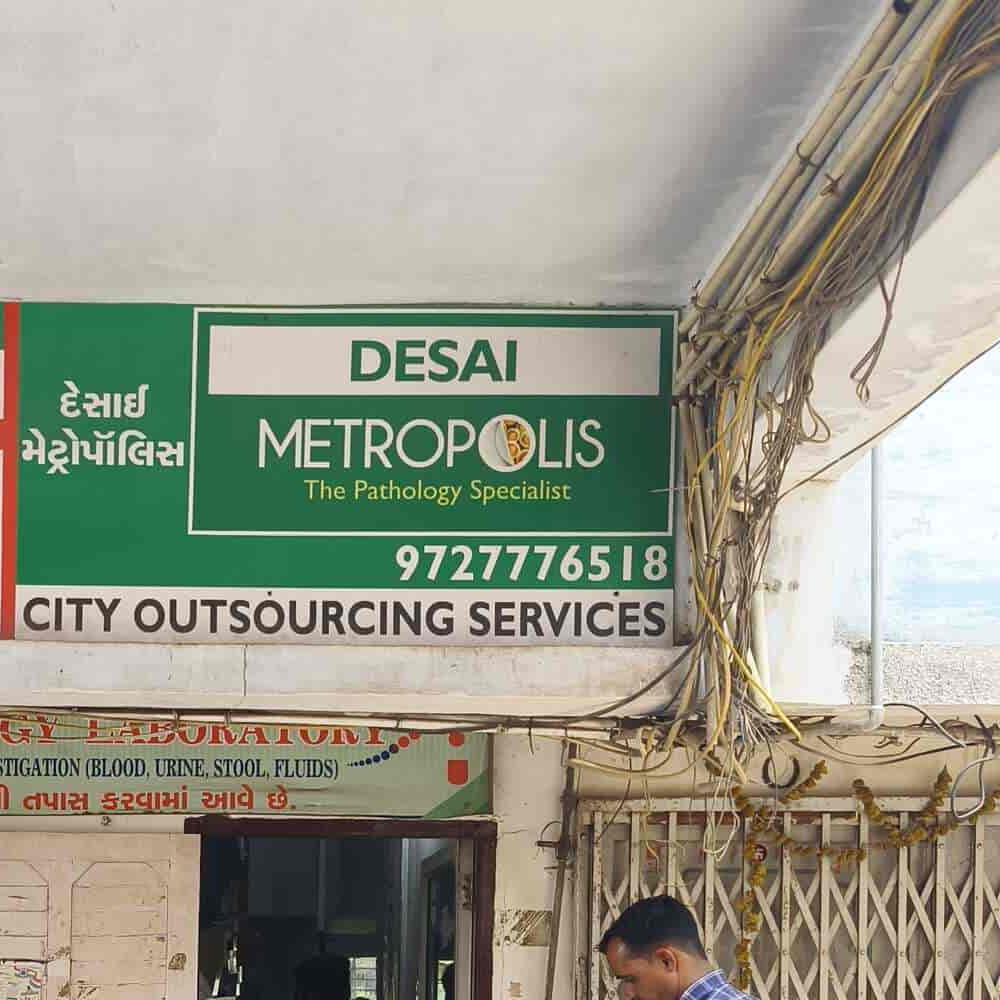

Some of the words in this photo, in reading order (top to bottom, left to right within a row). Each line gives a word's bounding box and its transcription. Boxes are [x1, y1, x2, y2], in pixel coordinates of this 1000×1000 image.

[350, 339, 518, 383] DESAI
[258, 414, 606, 472] METROPOLIS
[303, 479, 346, 500] The
[354, 479, 463, 506] Pathology
[470, 480, 571, 505] Specialist
[396, 543, 669, 583] 9727776518
[22, 597, 121, 633] CITY
[133, 598, 455, 636] OUTSOURCING
[468, 599, 667, 637] SERVICES
[86, 757, 149, 779] (BLOOD,
[155, 757, 209, 779] URINE,
[213, 758, 270, 780] STOOL,
[275, 758, 339, 780] FLUIDS)
[23, 790, 89, 810] તપાસ
[100, 785, 188, 811] કરવામાં
[201, 783, 254, 810] આવે
